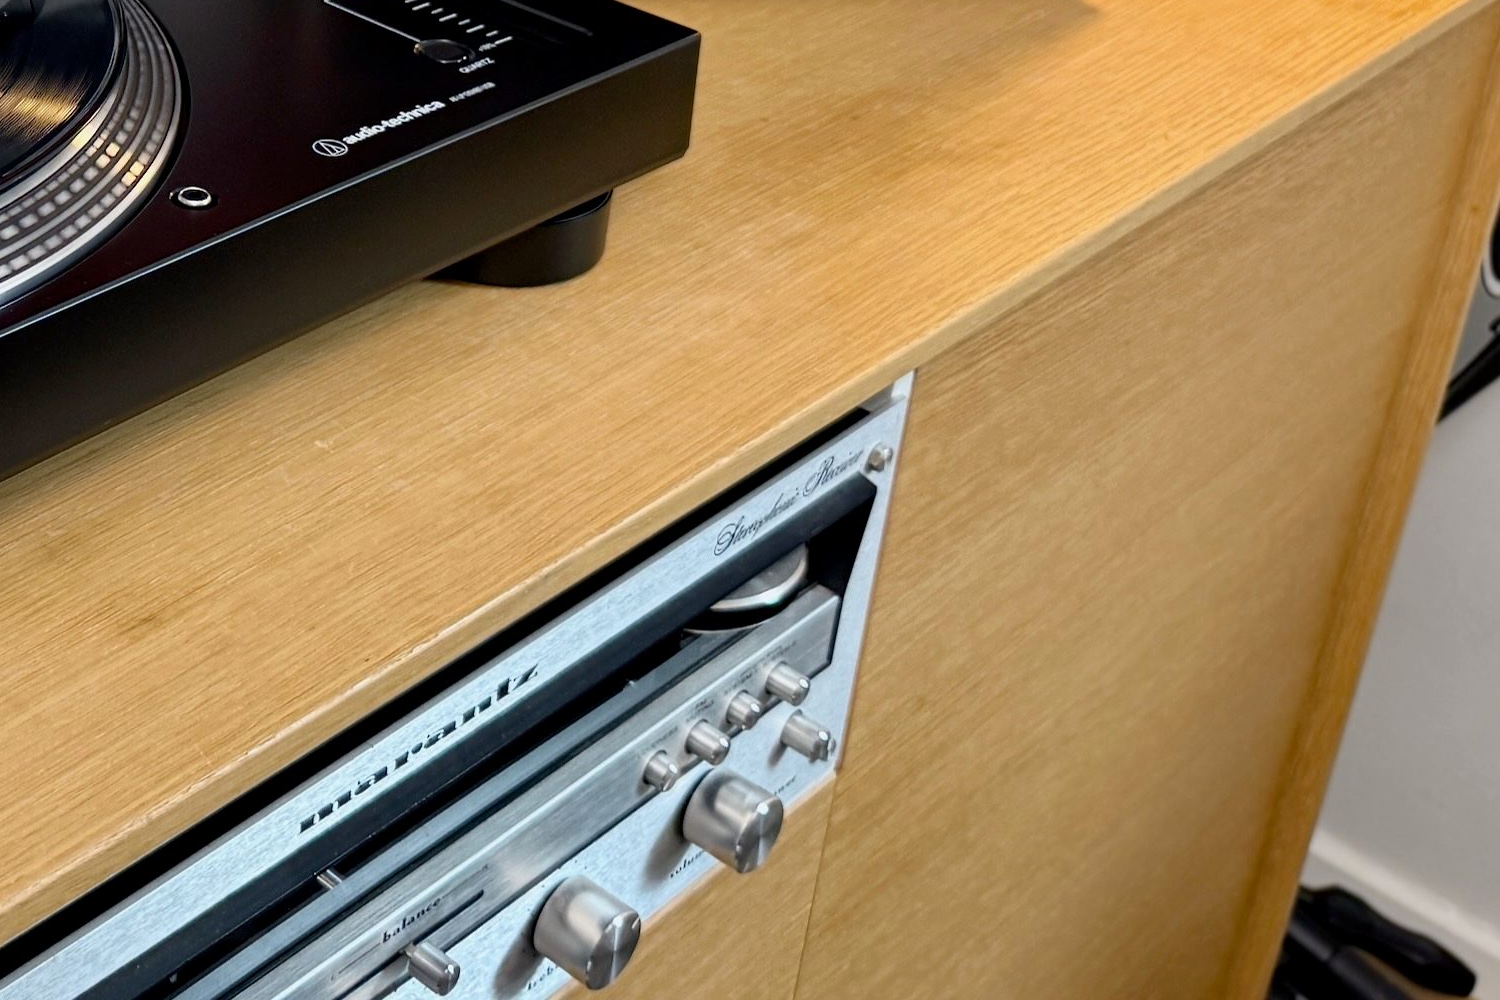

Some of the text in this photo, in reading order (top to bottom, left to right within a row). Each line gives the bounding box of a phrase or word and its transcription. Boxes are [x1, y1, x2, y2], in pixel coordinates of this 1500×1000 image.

[343, 101, 446, 144] audio-technica
[300, 664, 538, 834] marantz
[382, 897, 441, 943] balance
